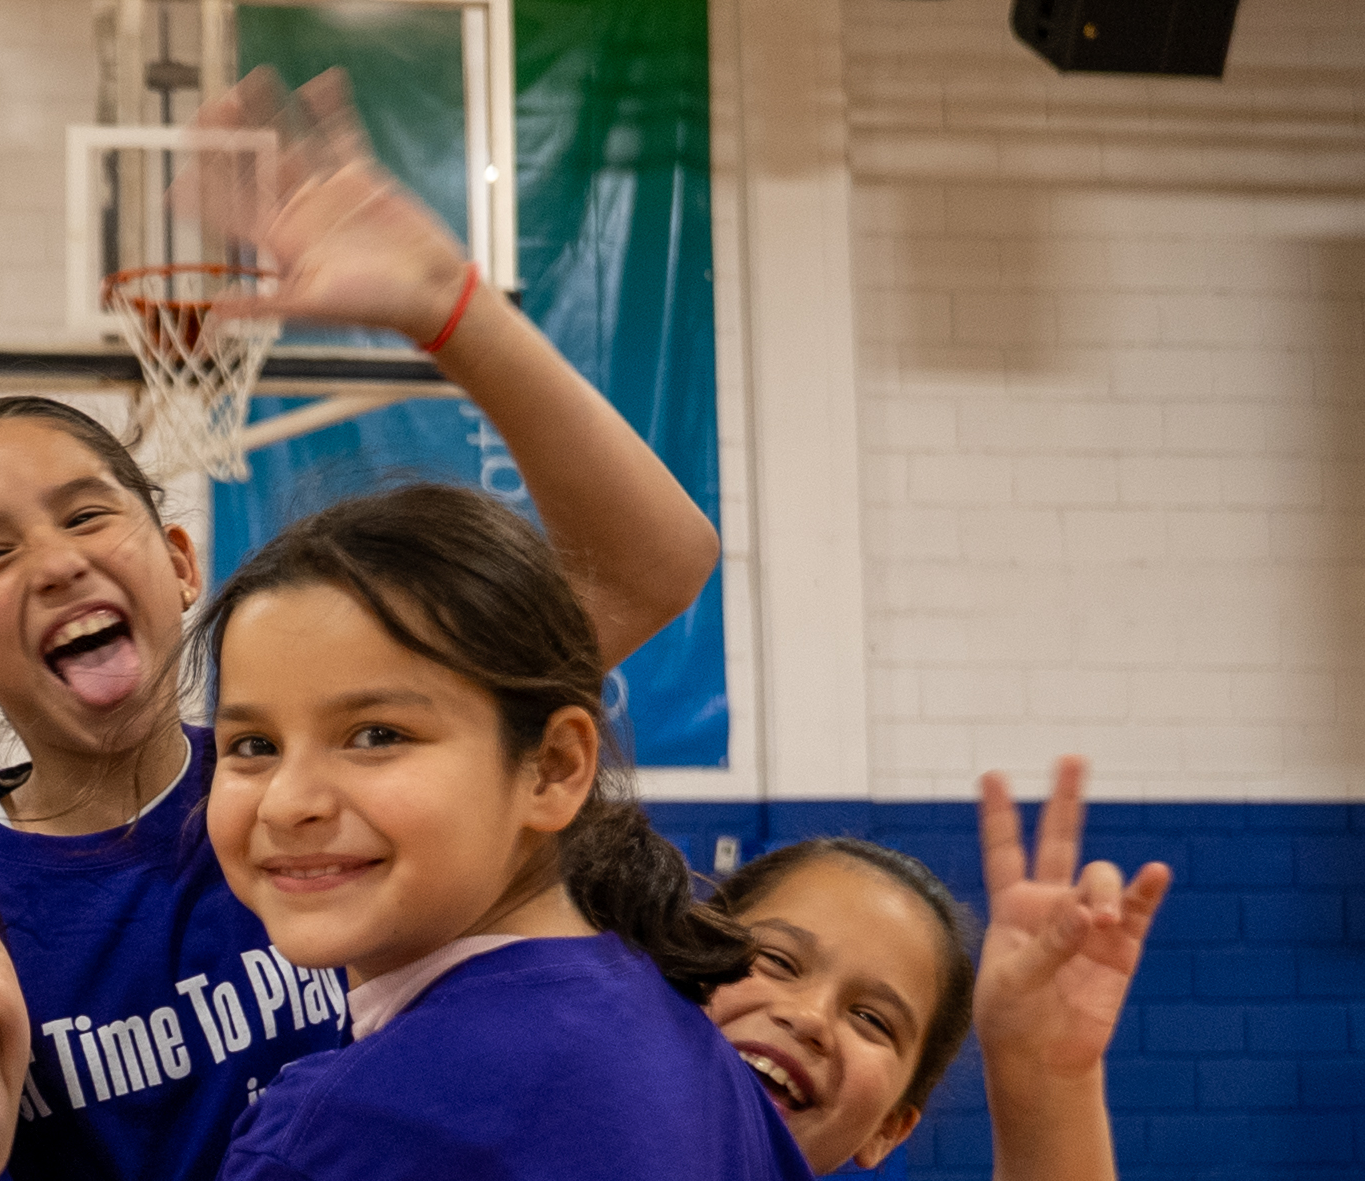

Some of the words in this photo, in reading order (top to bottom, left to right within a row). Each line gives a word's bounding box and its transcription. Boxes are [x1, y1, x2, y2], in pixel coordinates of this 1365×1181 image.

[41, 1006, 192, 1109] Time
[175, 973, 252, 1064] To
[240, 944, 346, 1040] Play
